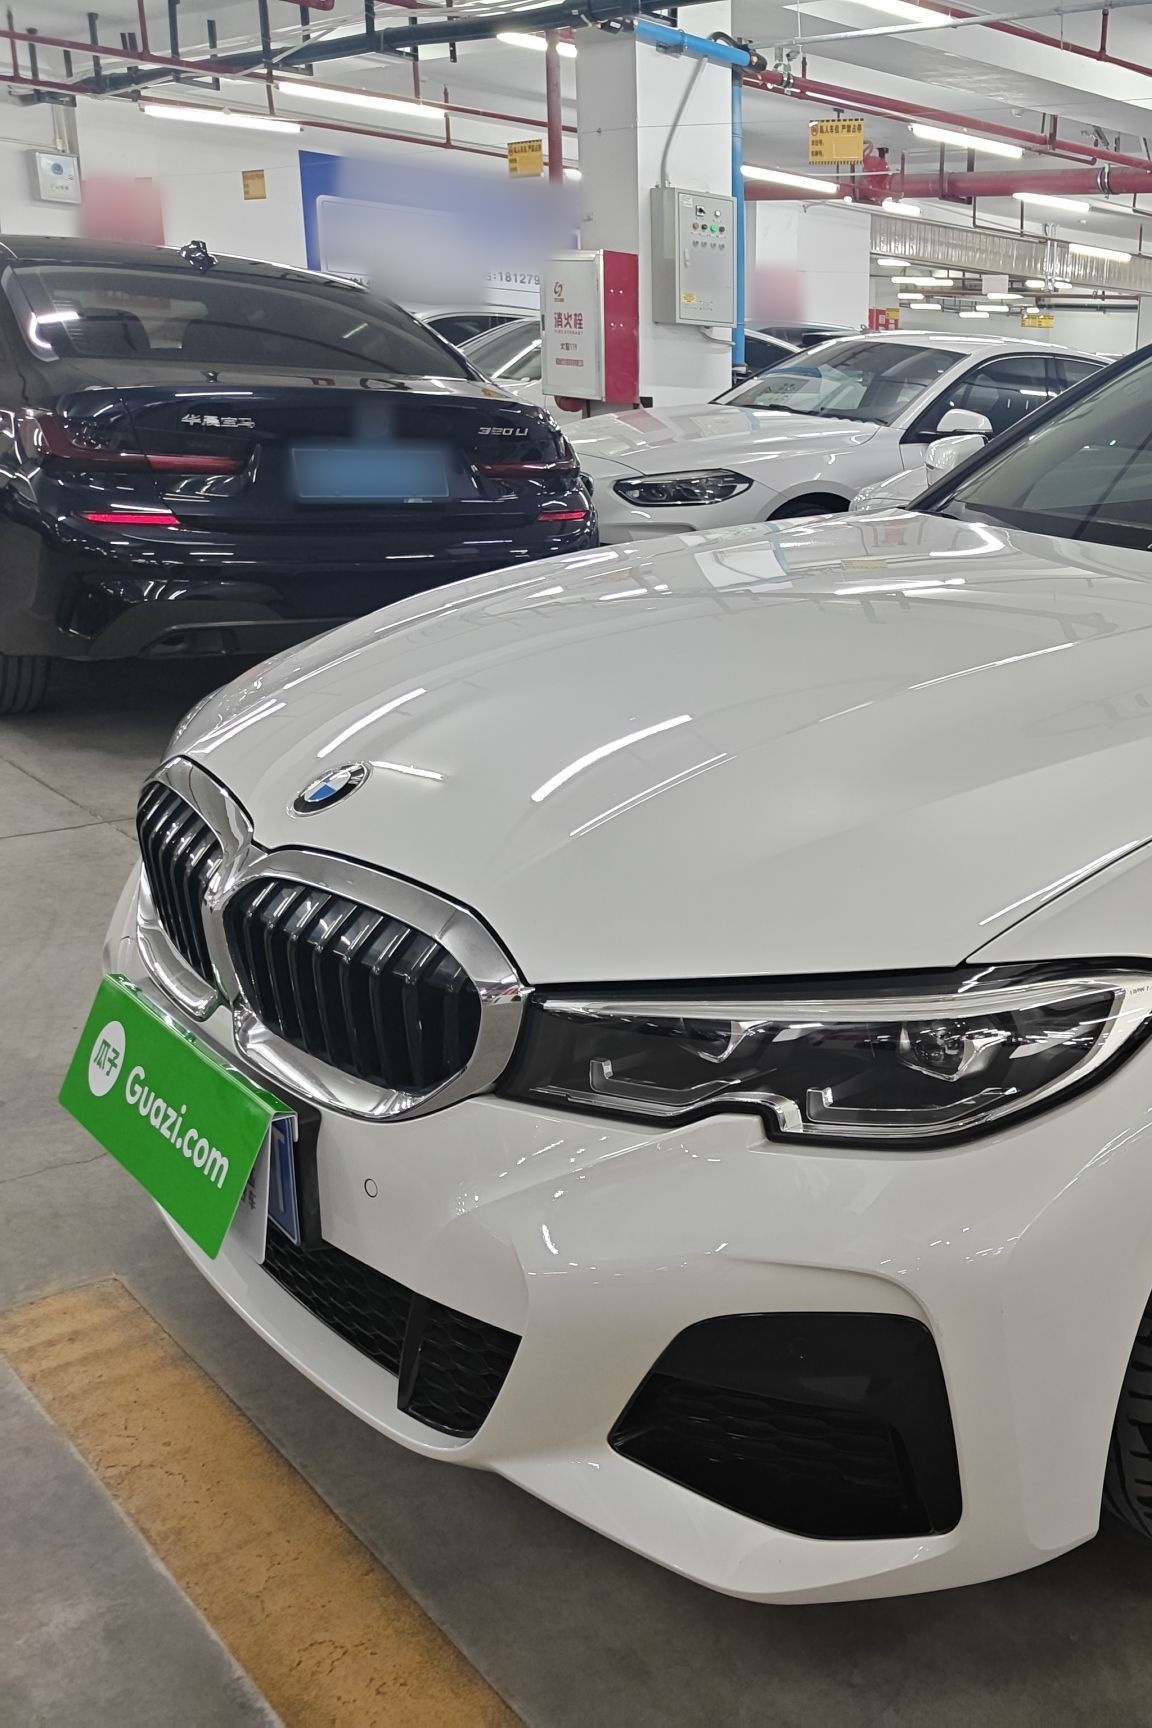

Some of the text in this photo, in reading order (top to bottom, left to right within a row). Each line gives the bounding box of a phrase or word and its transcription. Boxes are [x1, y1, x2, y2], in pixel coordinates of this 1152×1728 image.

[554, 312, 583, 329] 消火栓
[94, 1039, 121, 1076] 瓜子
[125, 1065, 230, 1190] Guazi.com
